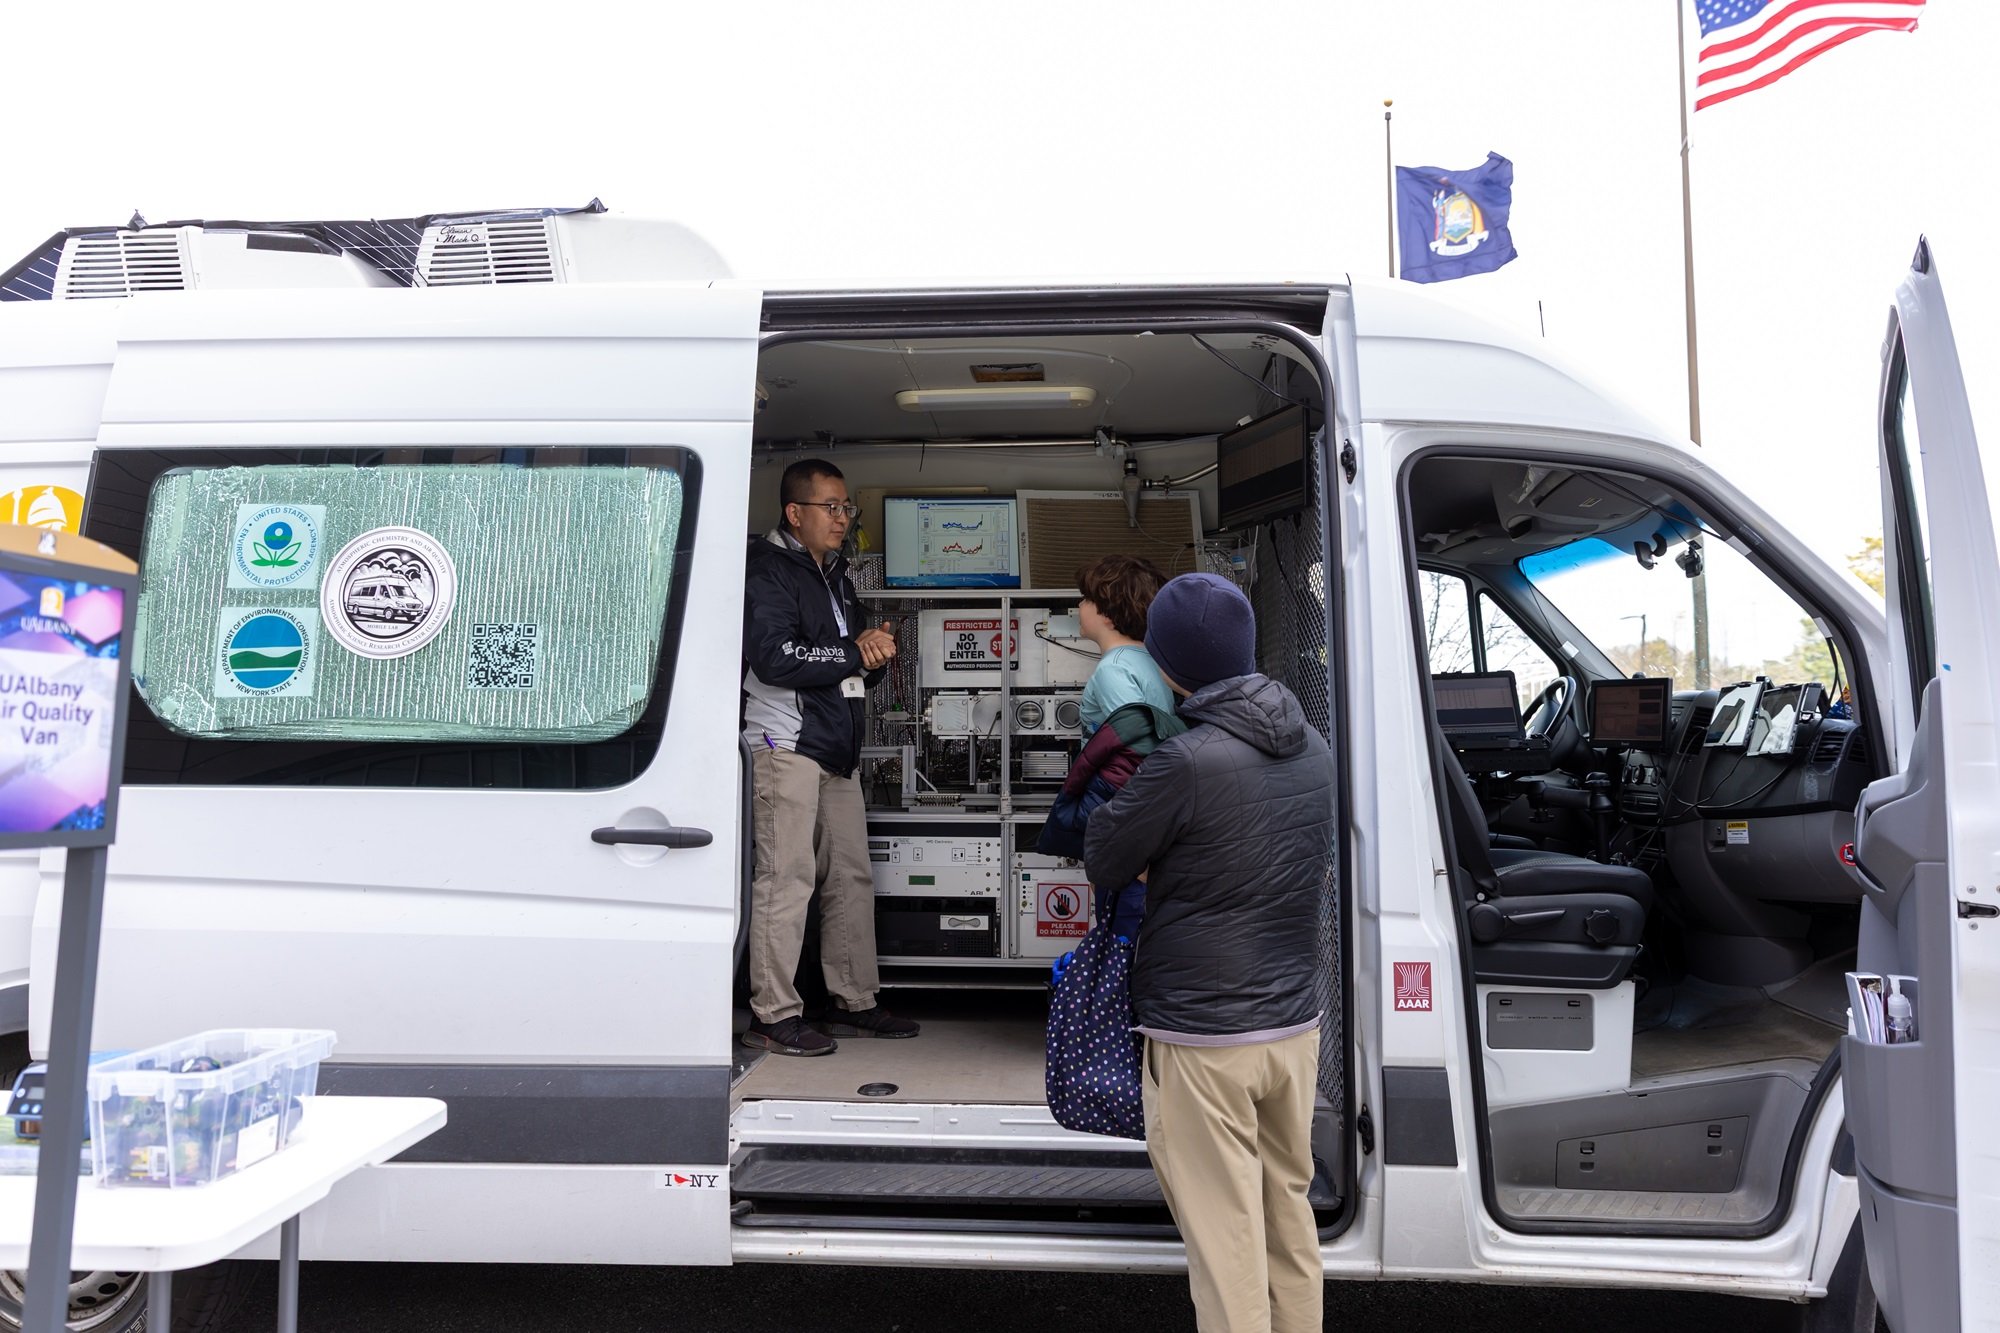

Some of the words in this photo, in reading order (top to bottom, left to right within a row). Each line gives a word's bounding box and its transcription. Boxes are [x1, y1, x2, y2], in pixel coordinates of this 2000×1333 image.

[254, 508, 280, 522] UNITED
[284, 508, 308, 522] STATES
[372, 536, 408, 544] CHEMISTRY
[410, 538, 423, 546] AND
[423, 544, 432, 554] AIR
[236, 528, 262, 584] ENVIRONMENTAL
[264, 560, 310, 585] PROTECTION
[308, 528, 316, 558] AGENCY
[222, 630, 235, 676] DEPARTMENT
[234, 621, 242, 630] OF
[242, 608, 296, 623] ENVIRONMENTAL
[296, 622, 310, 673] CONSERVATION
[960, 633, 975, 642] DO
[956, 642, 978, 650] NOT
[992, 641, 1014, 651] STP
[950, 651, 985, 659] ENTER
[0, 674, 84, 702] UAlbany
[236, 683, 250, 694] NEW
[271, 681, 291, 694] STATE
[0, 702, 18, 719] ir
[22, 702, 94, 726] Quality
[20, 726, 58, 744] Van
[1398, 999, 1430, 1008] AAAR
[664, 1174, 672, 1186] I
[690, 1174, 719, 1188] NY
